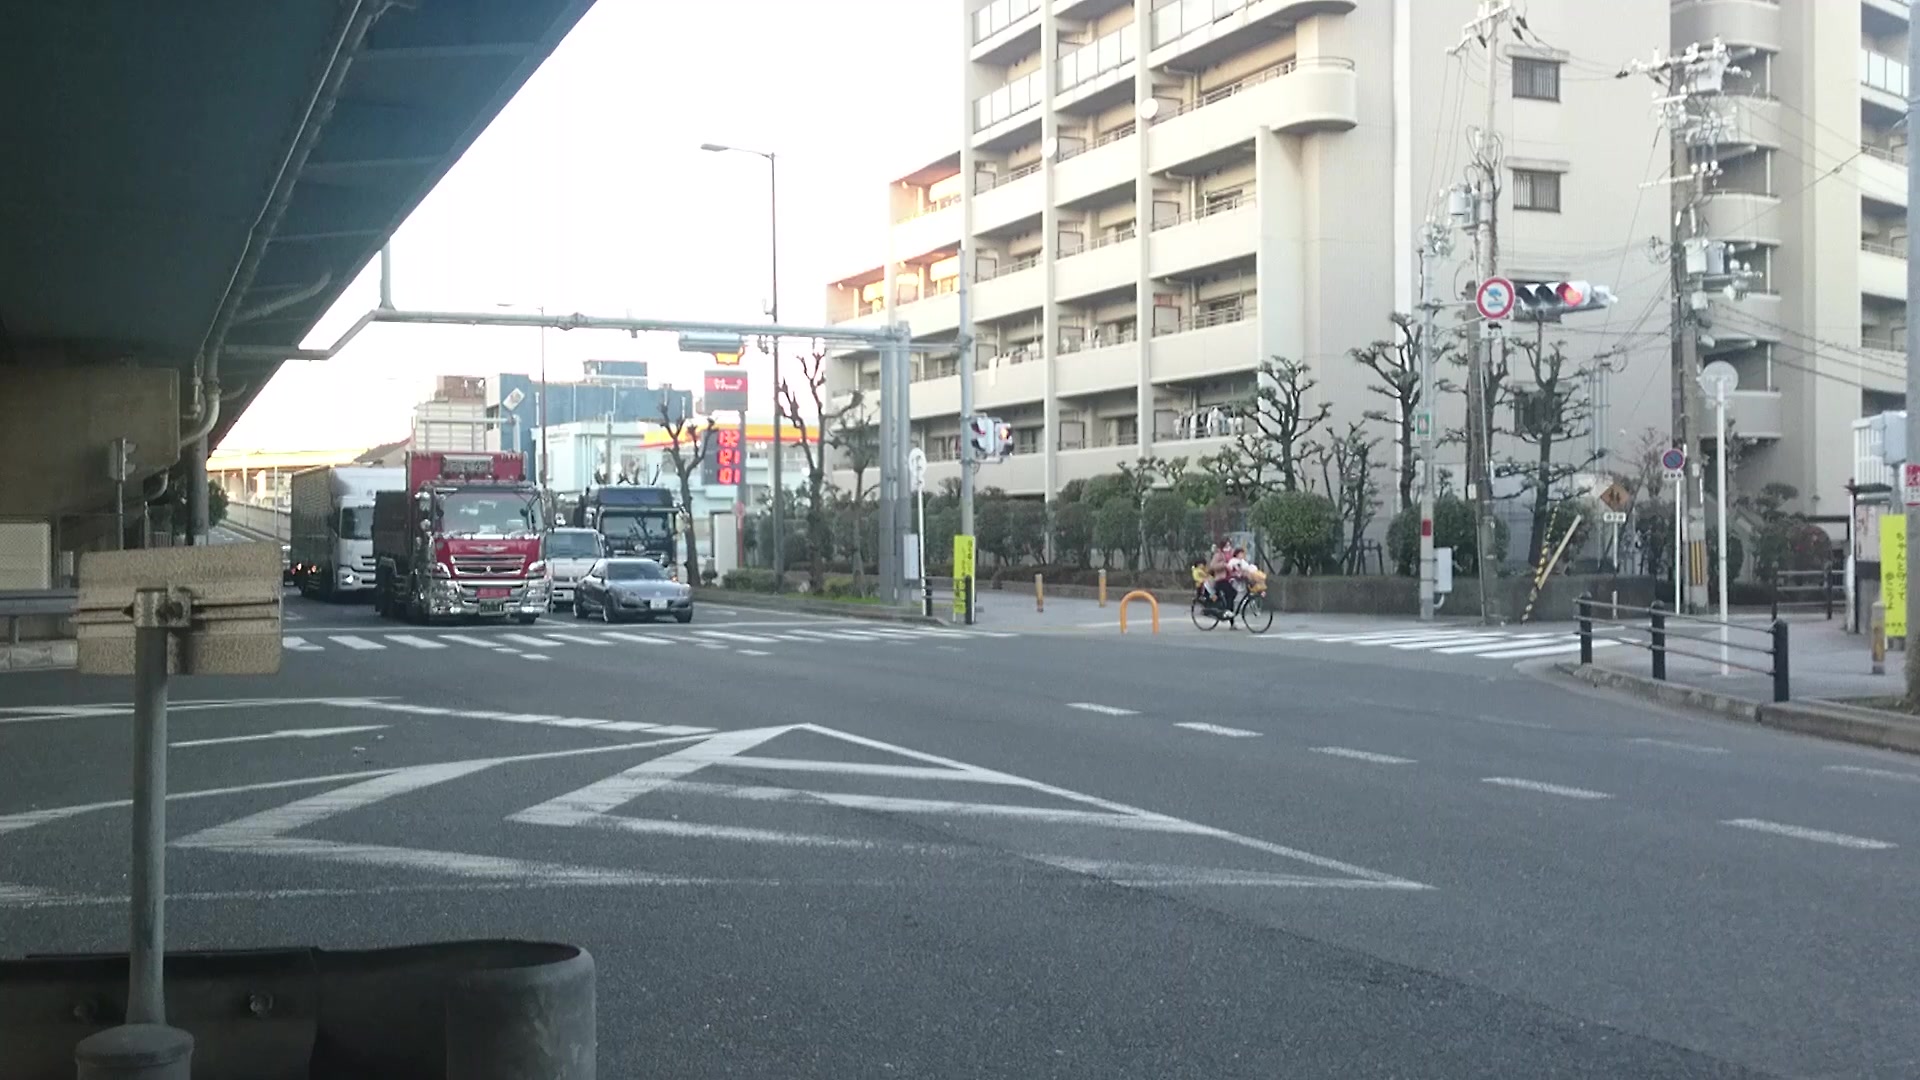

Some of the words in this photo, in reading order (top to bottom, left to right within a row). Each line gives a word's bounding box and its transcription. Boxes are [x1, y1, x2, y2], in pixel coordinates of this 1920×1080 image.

[718, 430, 740, 447] 132
[718, 448, 741, 466] 121
[718, 467, 741, 485] 101
